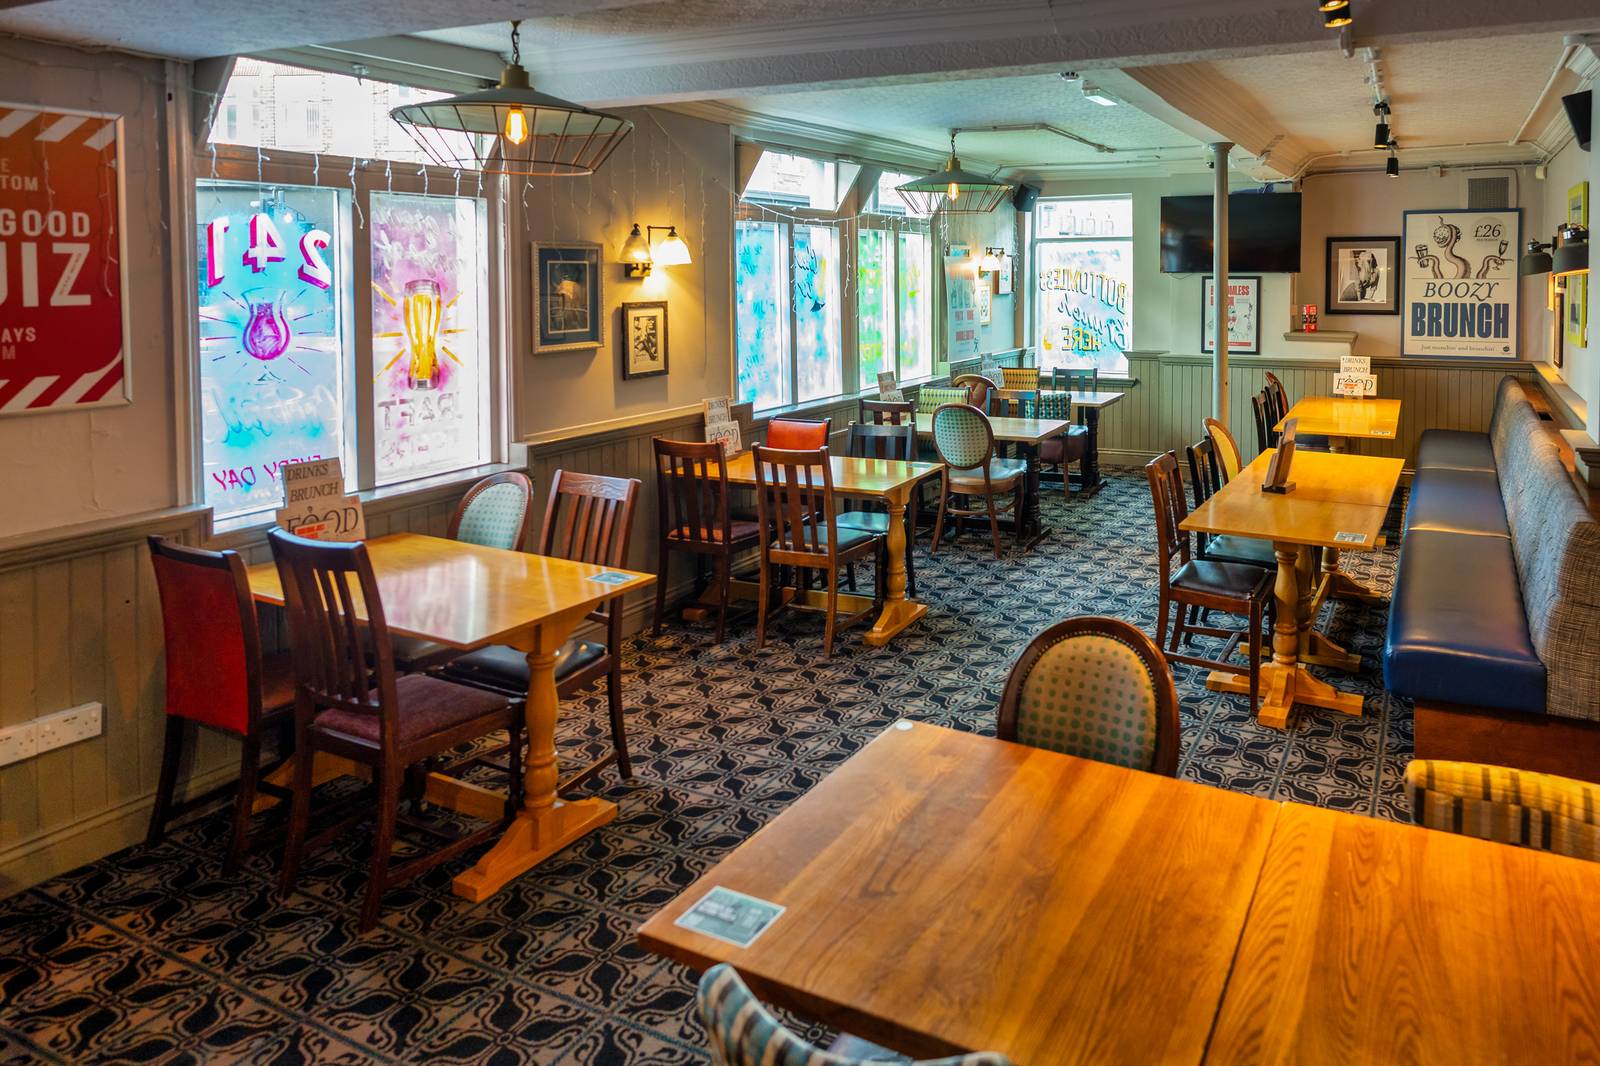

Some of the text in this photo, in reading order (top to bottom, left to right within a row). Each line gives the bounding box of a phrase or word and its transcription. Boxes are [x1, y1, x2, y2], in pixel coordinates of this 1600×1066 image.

[0, 208, 91, 238] GOOD
[1473, 223, 1502, 238] £26
[1422, 281, 1500, 302] BOOZY
[1411, 302, 1510, 339] BRUNCH
[287, 463, 329, 480] DRINKS
[290, 481, 339, 502] BRUNCH
